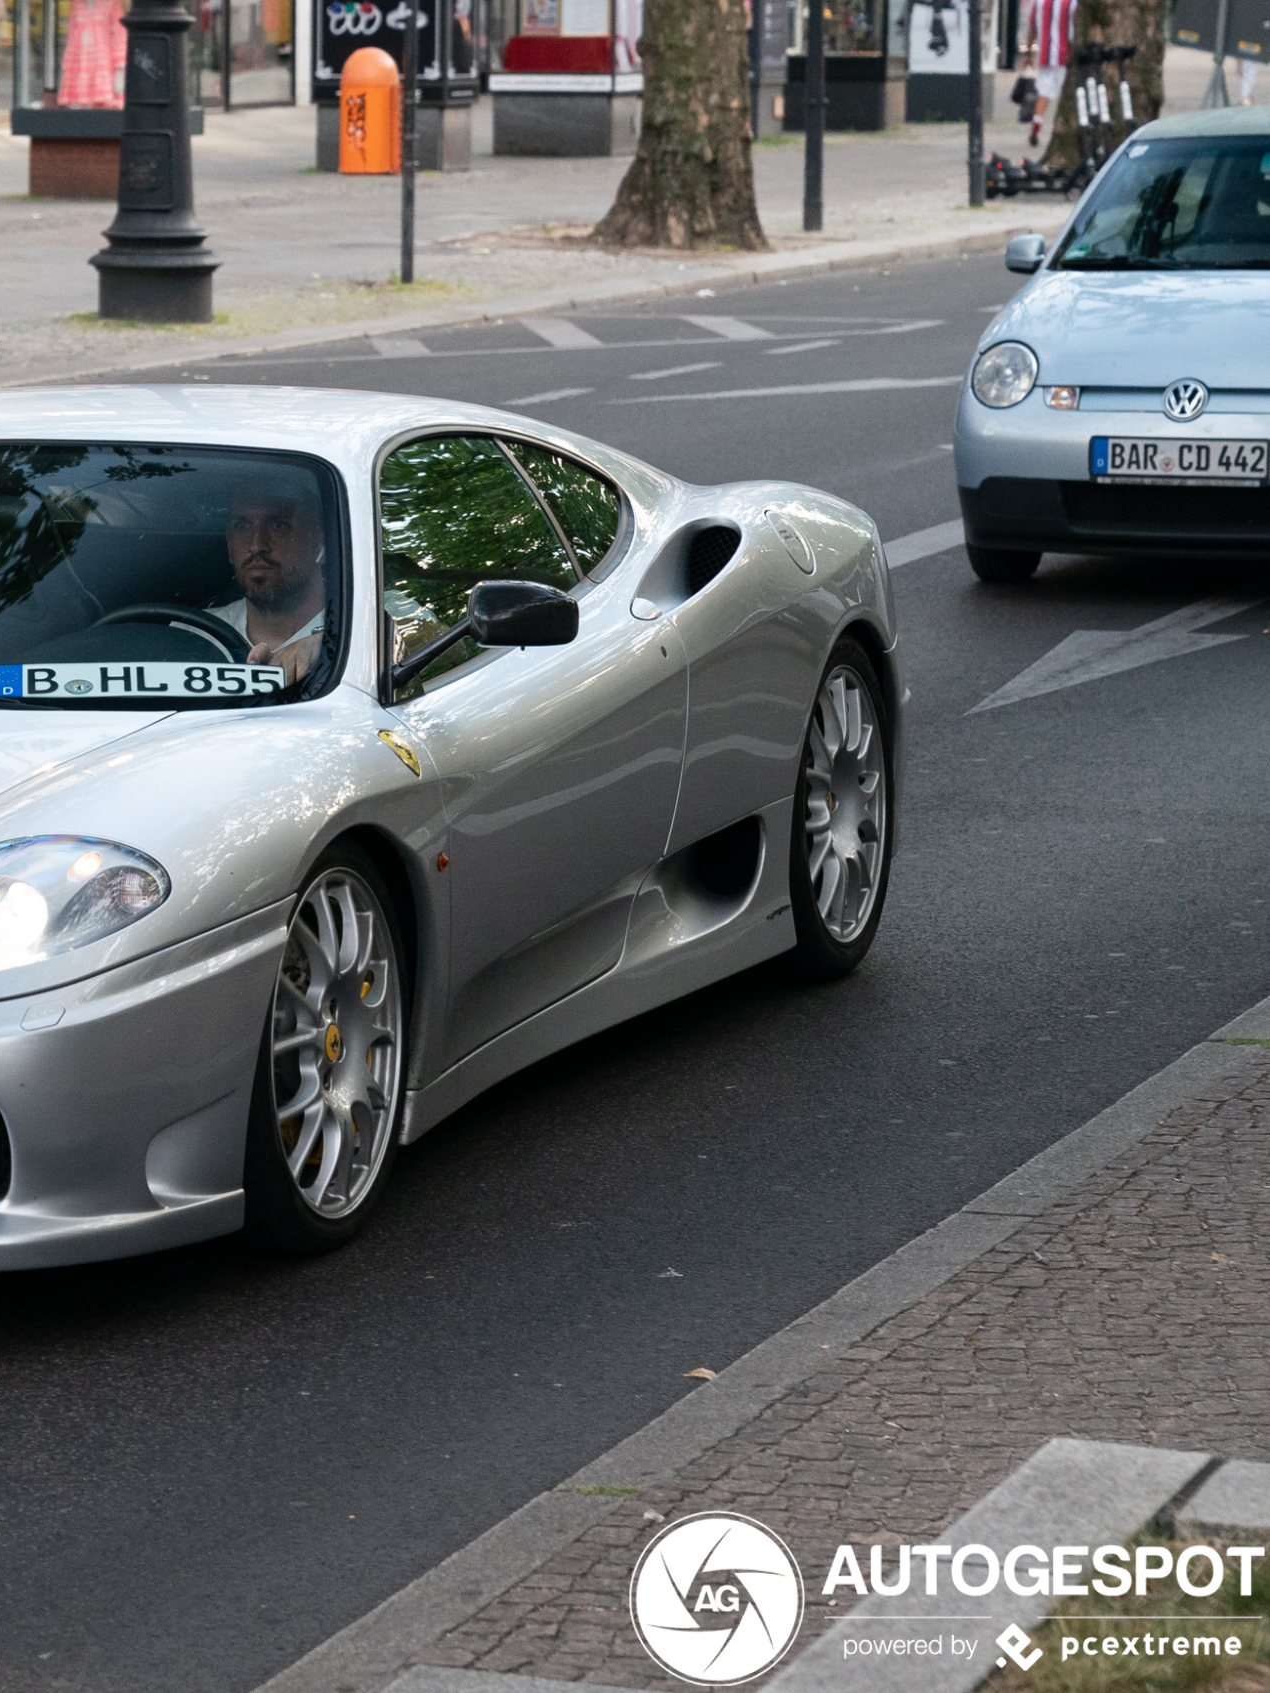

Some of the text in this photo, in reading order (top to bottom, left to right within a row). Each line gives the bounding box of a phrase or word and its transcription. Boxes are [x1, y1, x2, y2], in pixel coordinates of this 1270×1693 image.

[1111, 443, 1158, 470] BAR
[1179, 444, 1210, 472] CD
[1218, 446, 1265, 473] 442
[2, 666, 280, 695] D B HL 855
